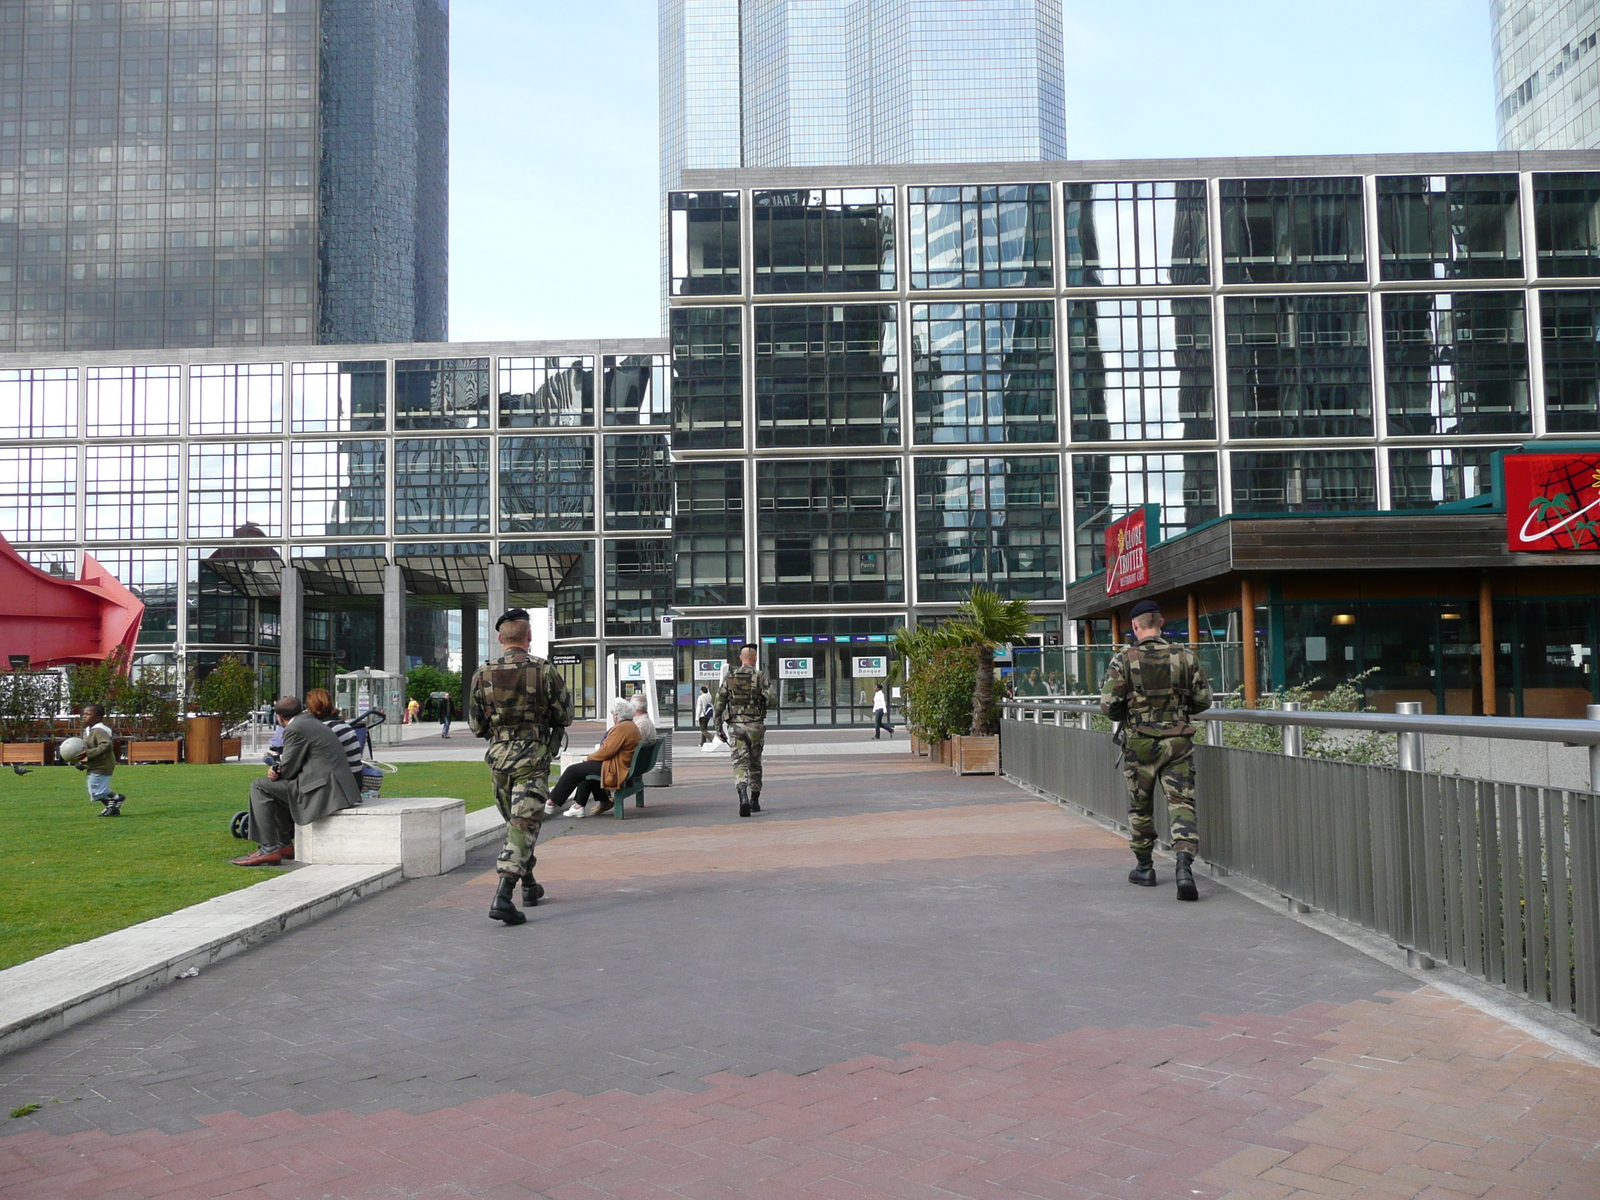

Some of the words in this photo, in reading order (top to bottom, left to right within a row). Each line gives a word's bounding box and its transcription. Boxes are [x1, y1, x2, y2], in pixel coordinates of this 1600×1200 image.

[1125, 525, 1142, 550] GLOBE
[1120, 547, 1144, 574] TROTTER
[785, 660, 807, 669] CIC
[859, 658, 880, 668] CIC
